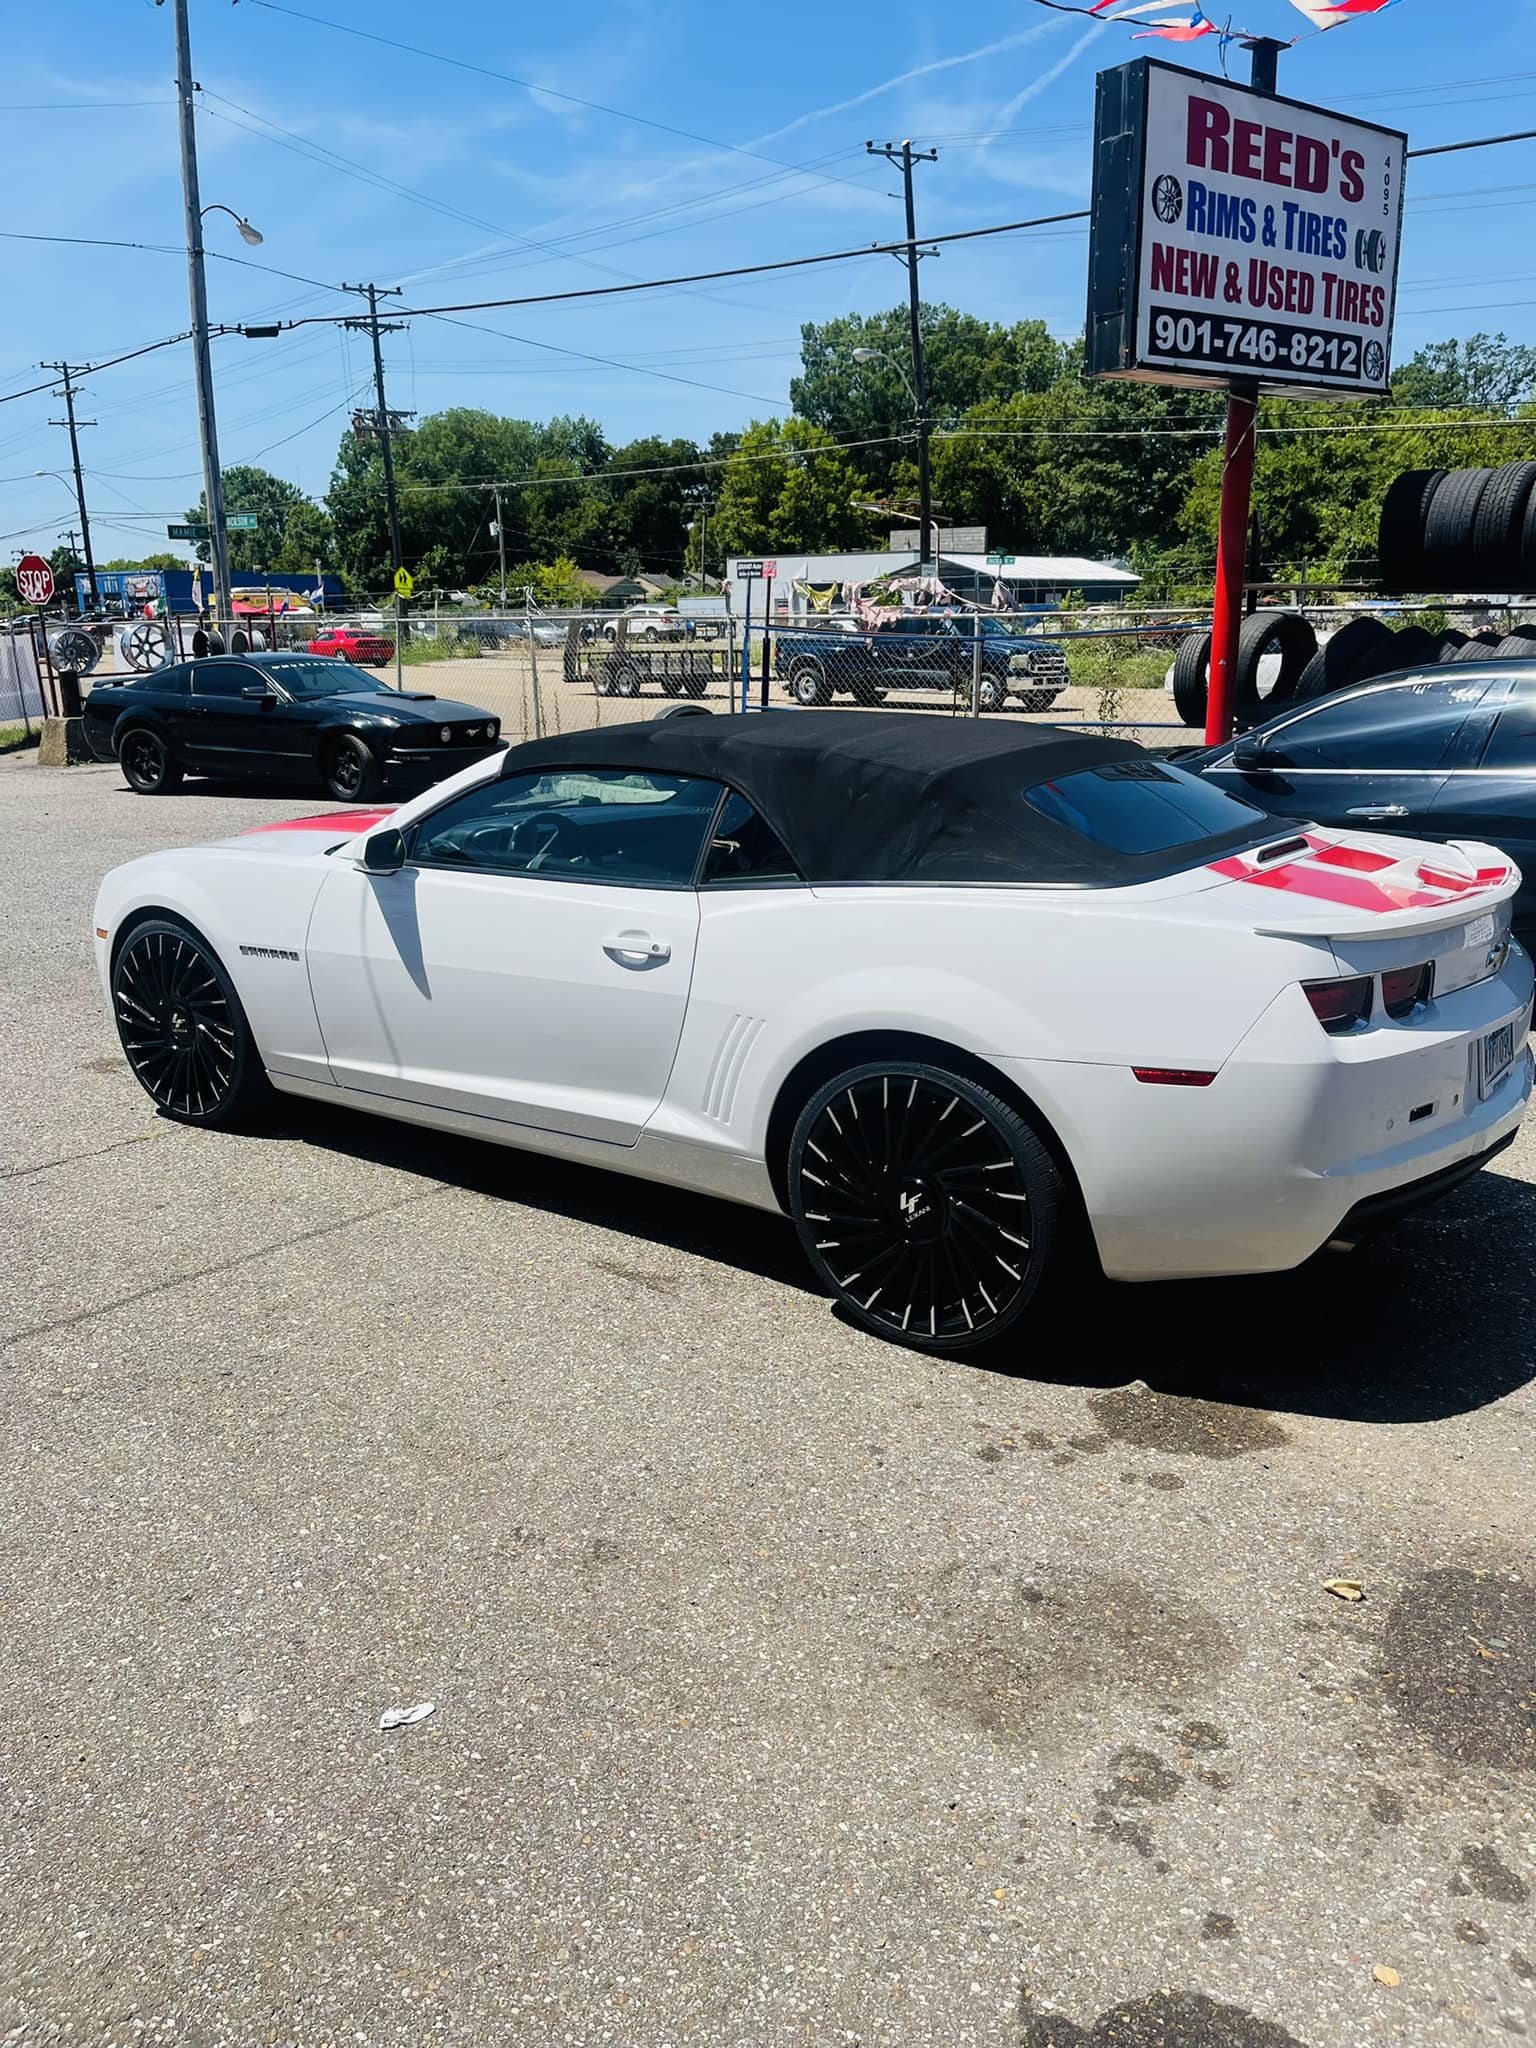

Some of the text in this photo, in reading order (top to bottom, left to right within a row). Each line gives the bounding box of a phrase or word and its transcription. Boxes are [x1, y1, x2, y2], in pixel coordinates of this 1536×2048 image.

[1186, 95, 1365, 203] REED'S
[1185, 179, 1348, 260] RIMS & TIRES
[1382, 155, 1391, 216] 4095
[1150, 242, 1386, 328] NEW & USED TIRES
[1154, 314, 1358, 374] 901-746-8212
[19, 570, 50, 590] STOP
